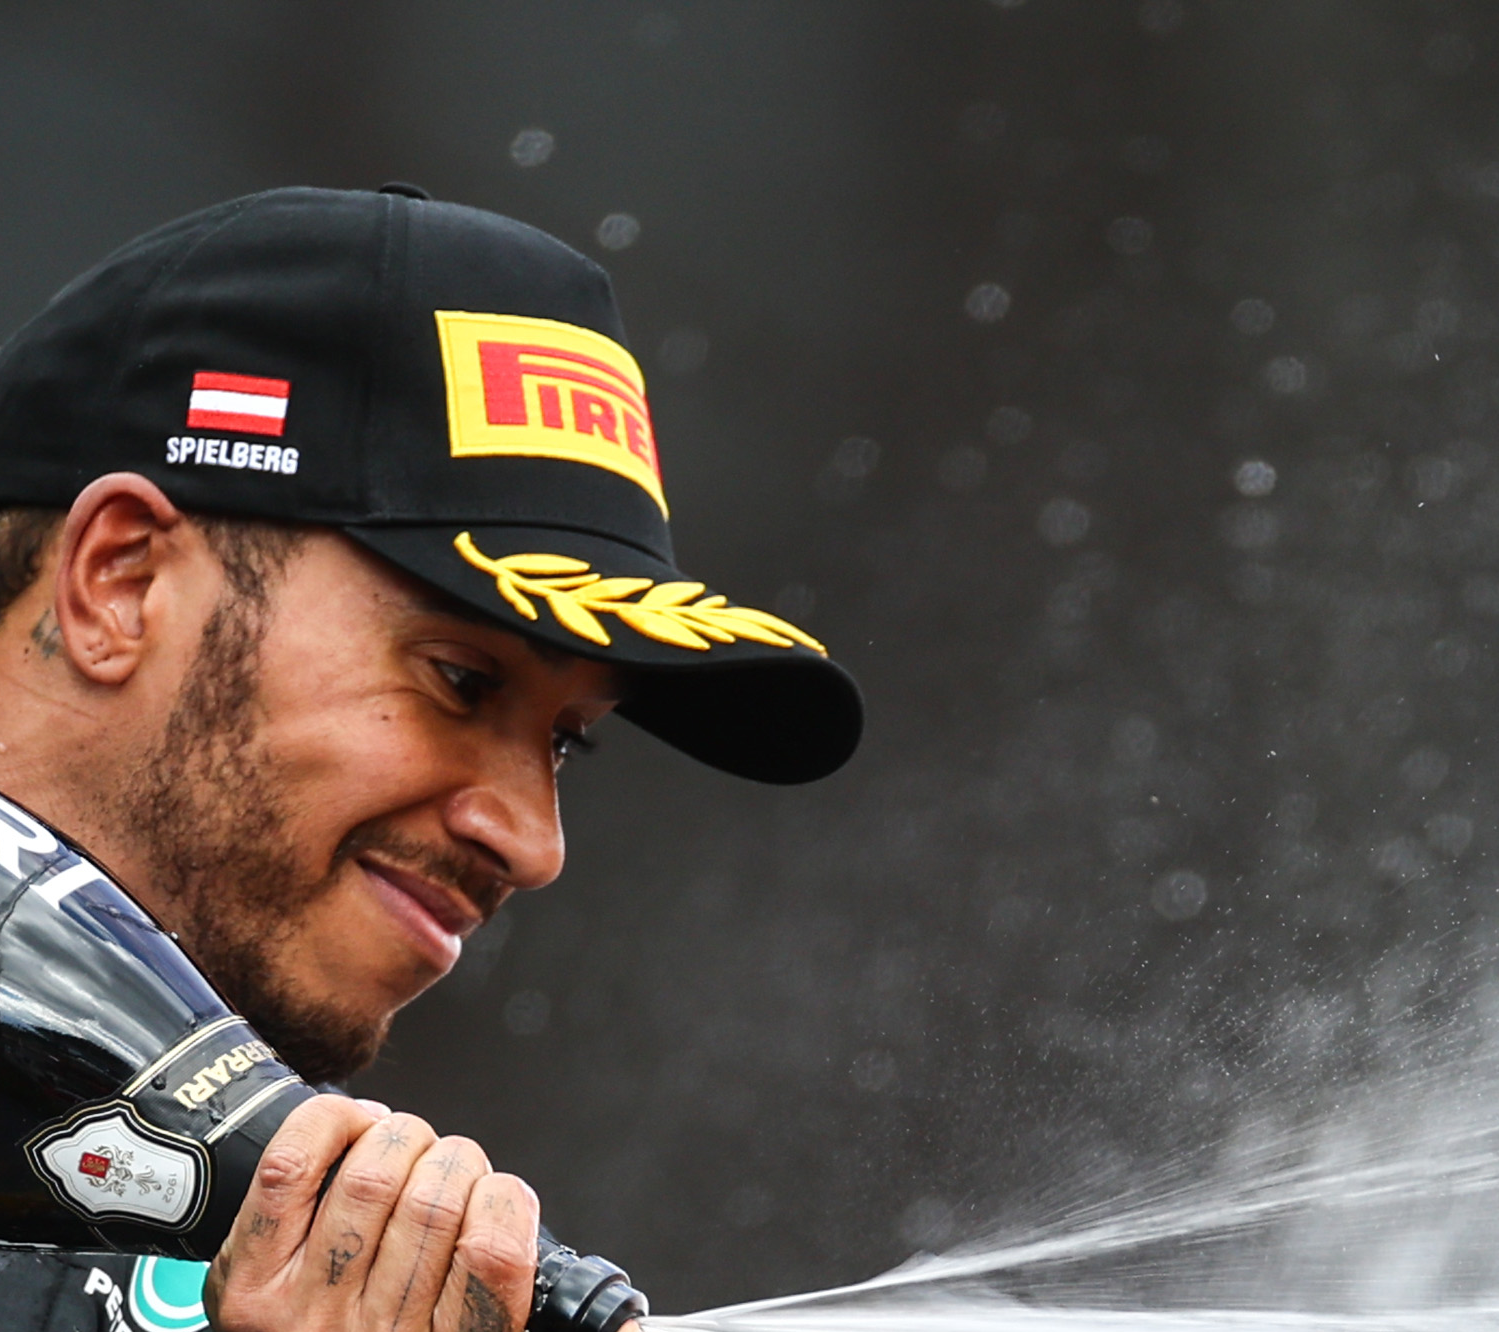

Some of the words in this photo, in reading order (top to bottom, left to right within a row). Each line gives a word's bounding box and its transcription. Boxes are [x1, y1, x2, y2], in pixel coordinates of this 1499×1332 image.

[477, 340, 662, 482] PIRE
[166, 436, 299, 475] SPIELBERG
[162, 1173, 178, 1204] 1902
